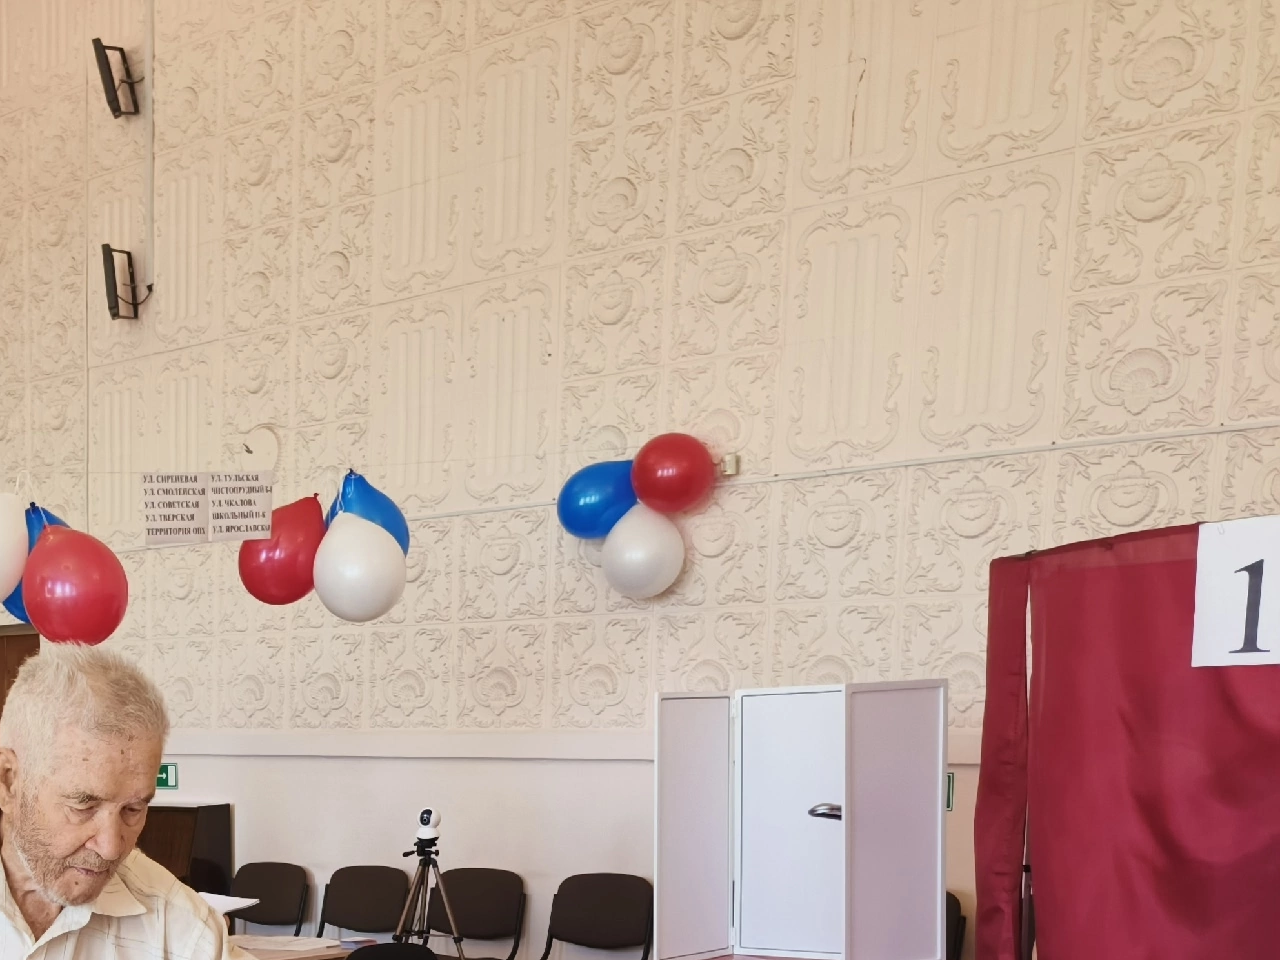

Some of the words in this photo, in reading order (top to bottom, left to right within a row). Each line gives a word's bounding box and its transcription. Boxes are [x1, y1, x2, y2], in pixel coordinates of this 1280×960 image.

[143, 475, 156, 483] УЛ.
[156, 475, 198, 483] СИРЕНЕВАЯ
[224, 474, 259, 482] ТУЛЬСКАЯ
[157, 488, 206, 496] СМОЛЕНСКАЯ
[157, 501, 200, 509] СОВЕТСКАЯ
[224, 499, 257, 507] ЧКАЛОВА
[159, 514, 195, 522] ТВЕРСКАЯ
[146, 527, 191, 536] ТЕРРИТОРИЯ
[1228, 559, 1270, 654] 1
